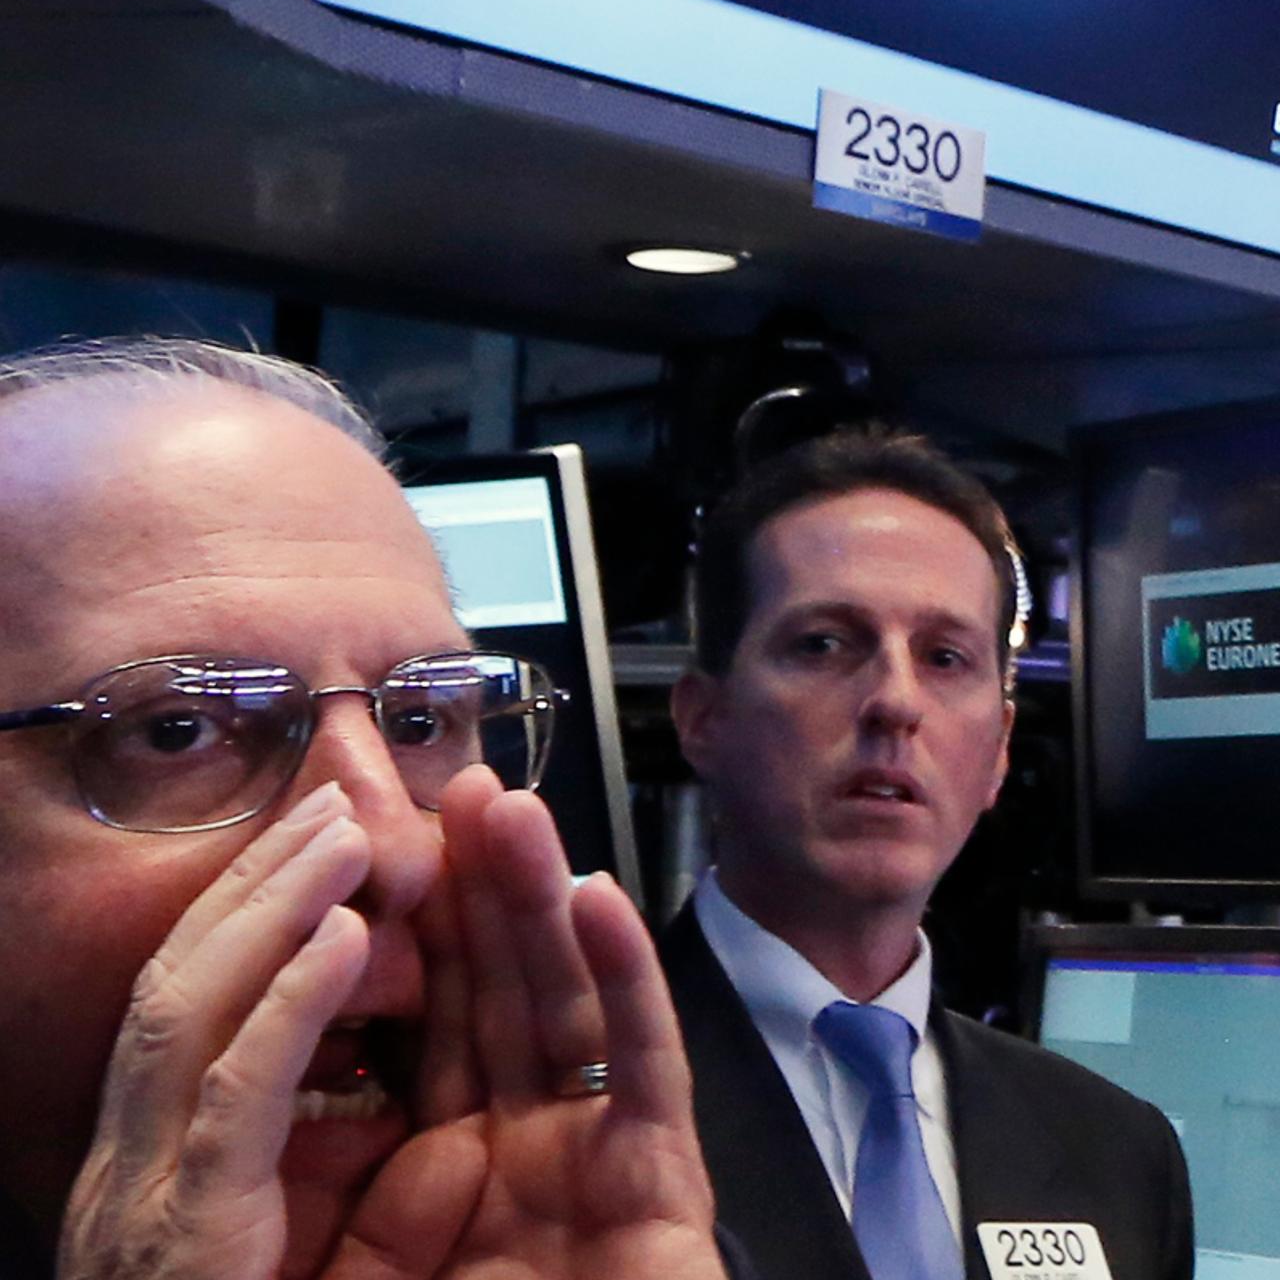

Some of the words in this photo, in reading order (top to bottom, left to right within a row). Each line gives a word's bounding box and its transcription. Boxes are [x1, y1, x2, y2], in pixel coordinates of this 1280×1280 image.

[844, 107, 962, 183] 2330
[1206, 617, 1255, 645] NYSE
[996, 1228, 1086, 1267] 2330
